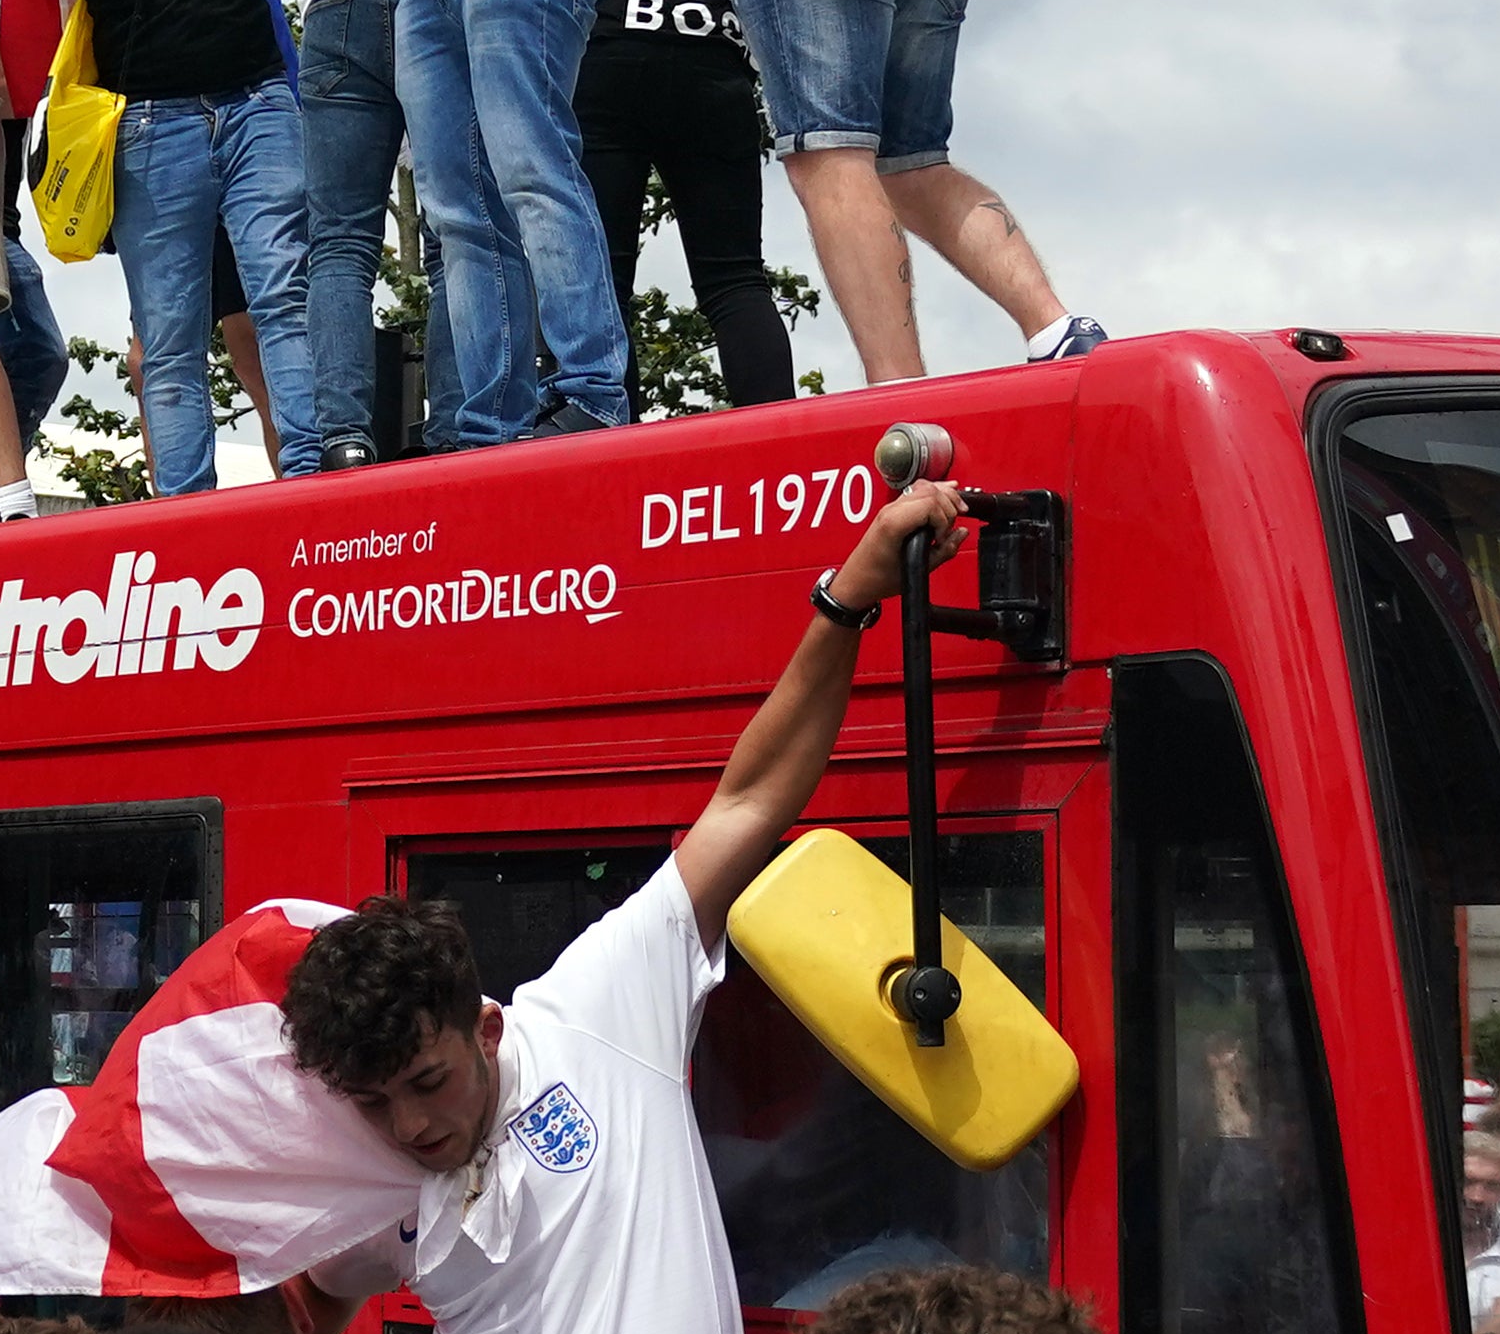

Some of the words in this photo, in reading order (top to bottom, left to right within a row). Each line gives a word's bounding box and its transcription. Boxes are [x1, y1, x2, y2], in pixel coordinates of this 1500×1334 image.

[641, 486, 740, 550] DEL
[748, 464, 874, 536] 1970
[291, 538, 308, 567] A
[314, 528, 407, 564] member
[413, 522, 437, 553] of
